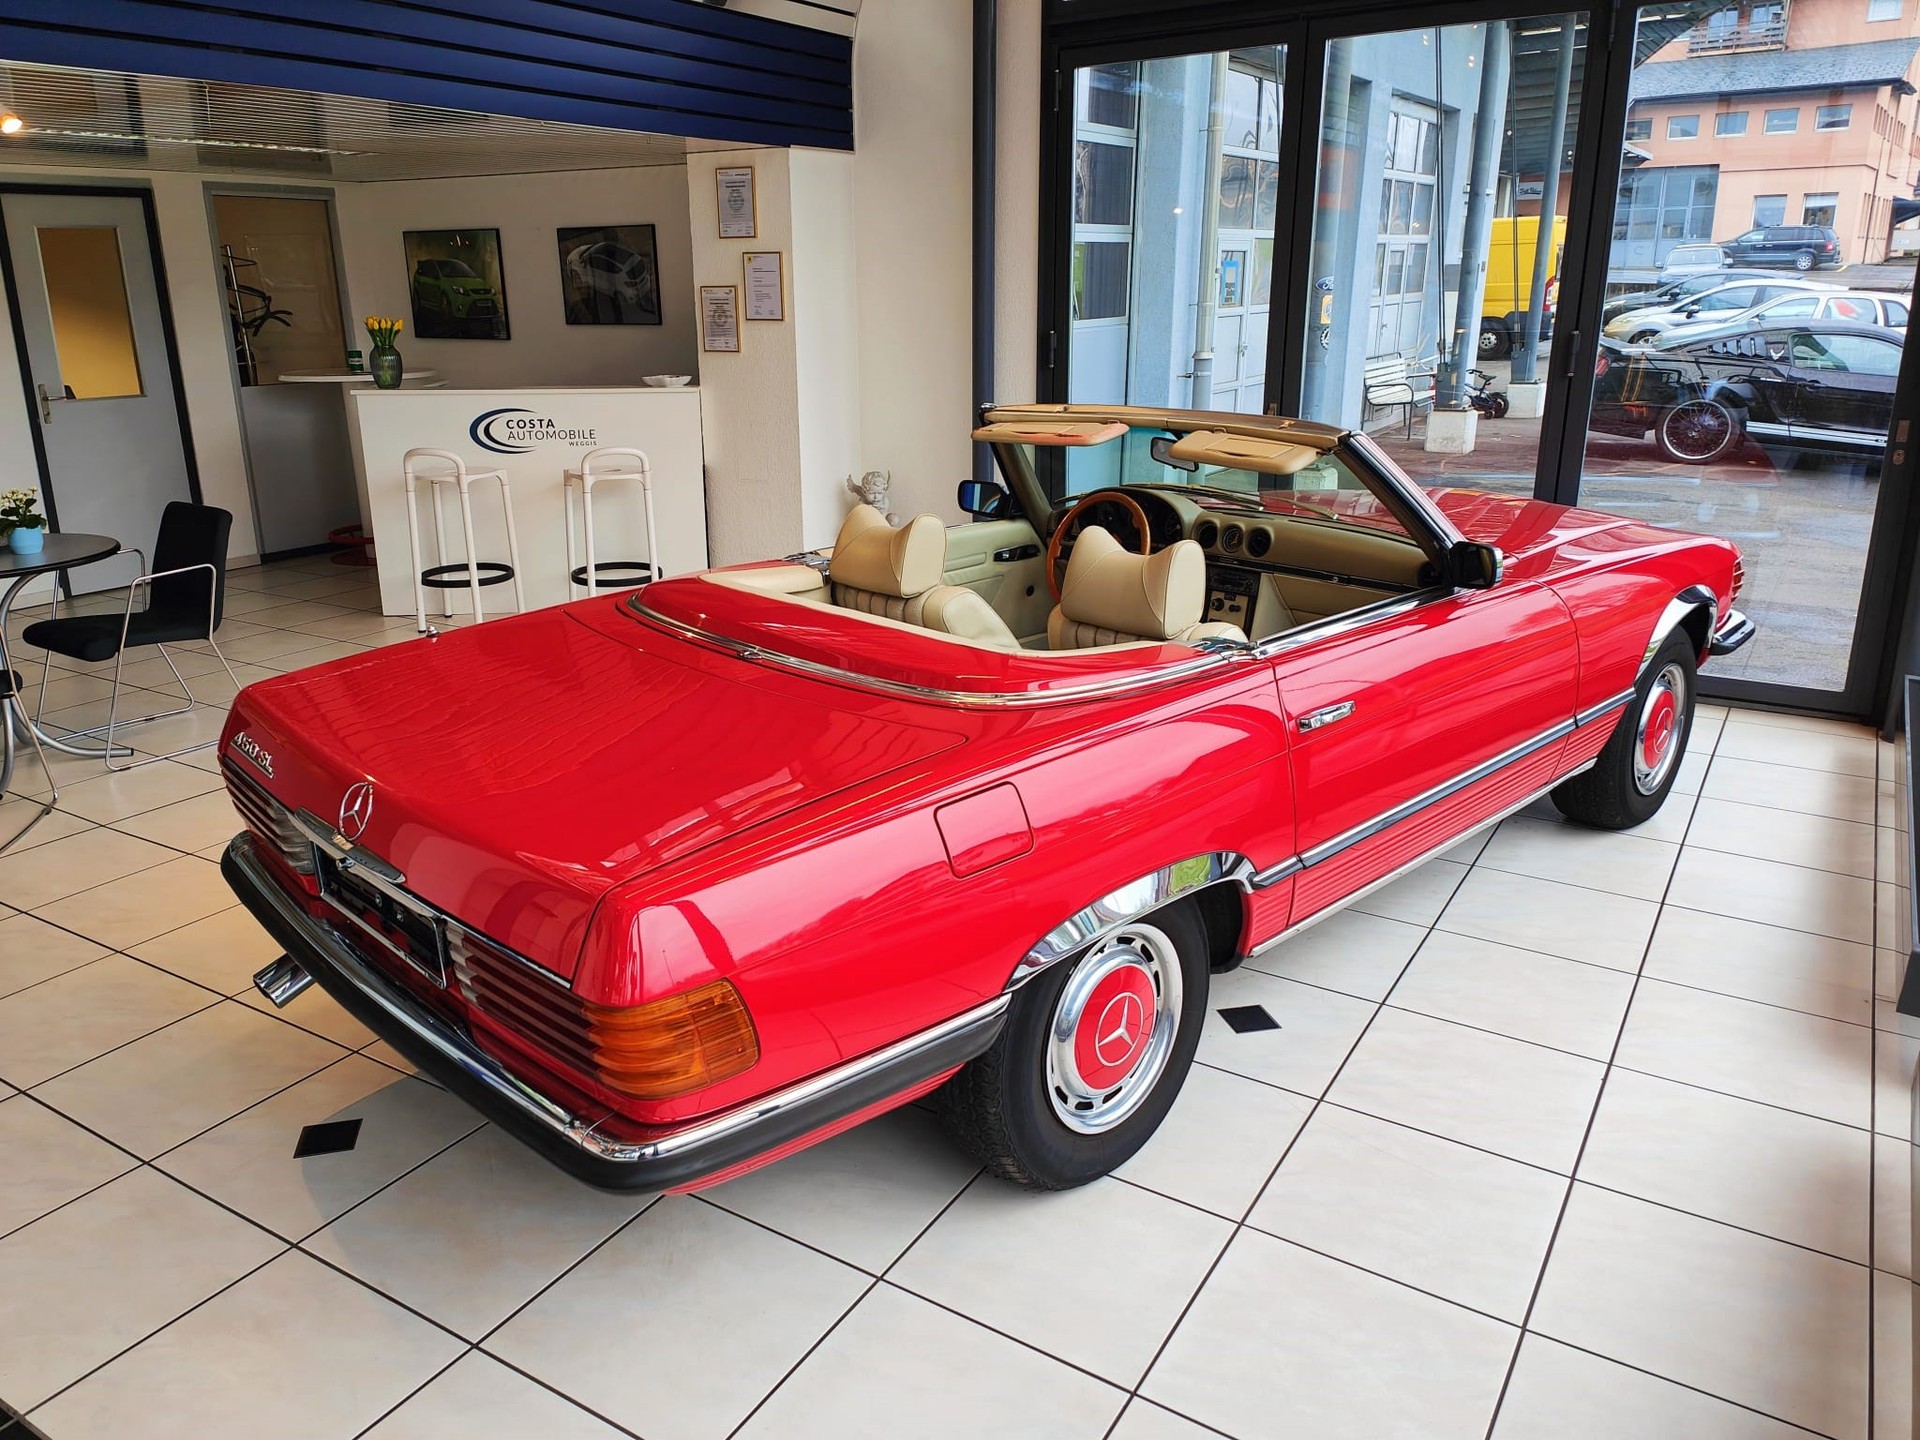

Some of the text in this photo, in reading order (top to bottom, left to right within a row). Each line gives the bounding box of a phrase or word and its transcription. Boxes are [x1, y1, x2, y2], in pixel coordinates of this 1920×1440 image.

[506, 418, 555, 429] COSTA
[508, 429, 596, 440] AUTOMOBILE
[234, 731, 274, 773] 450 SL
